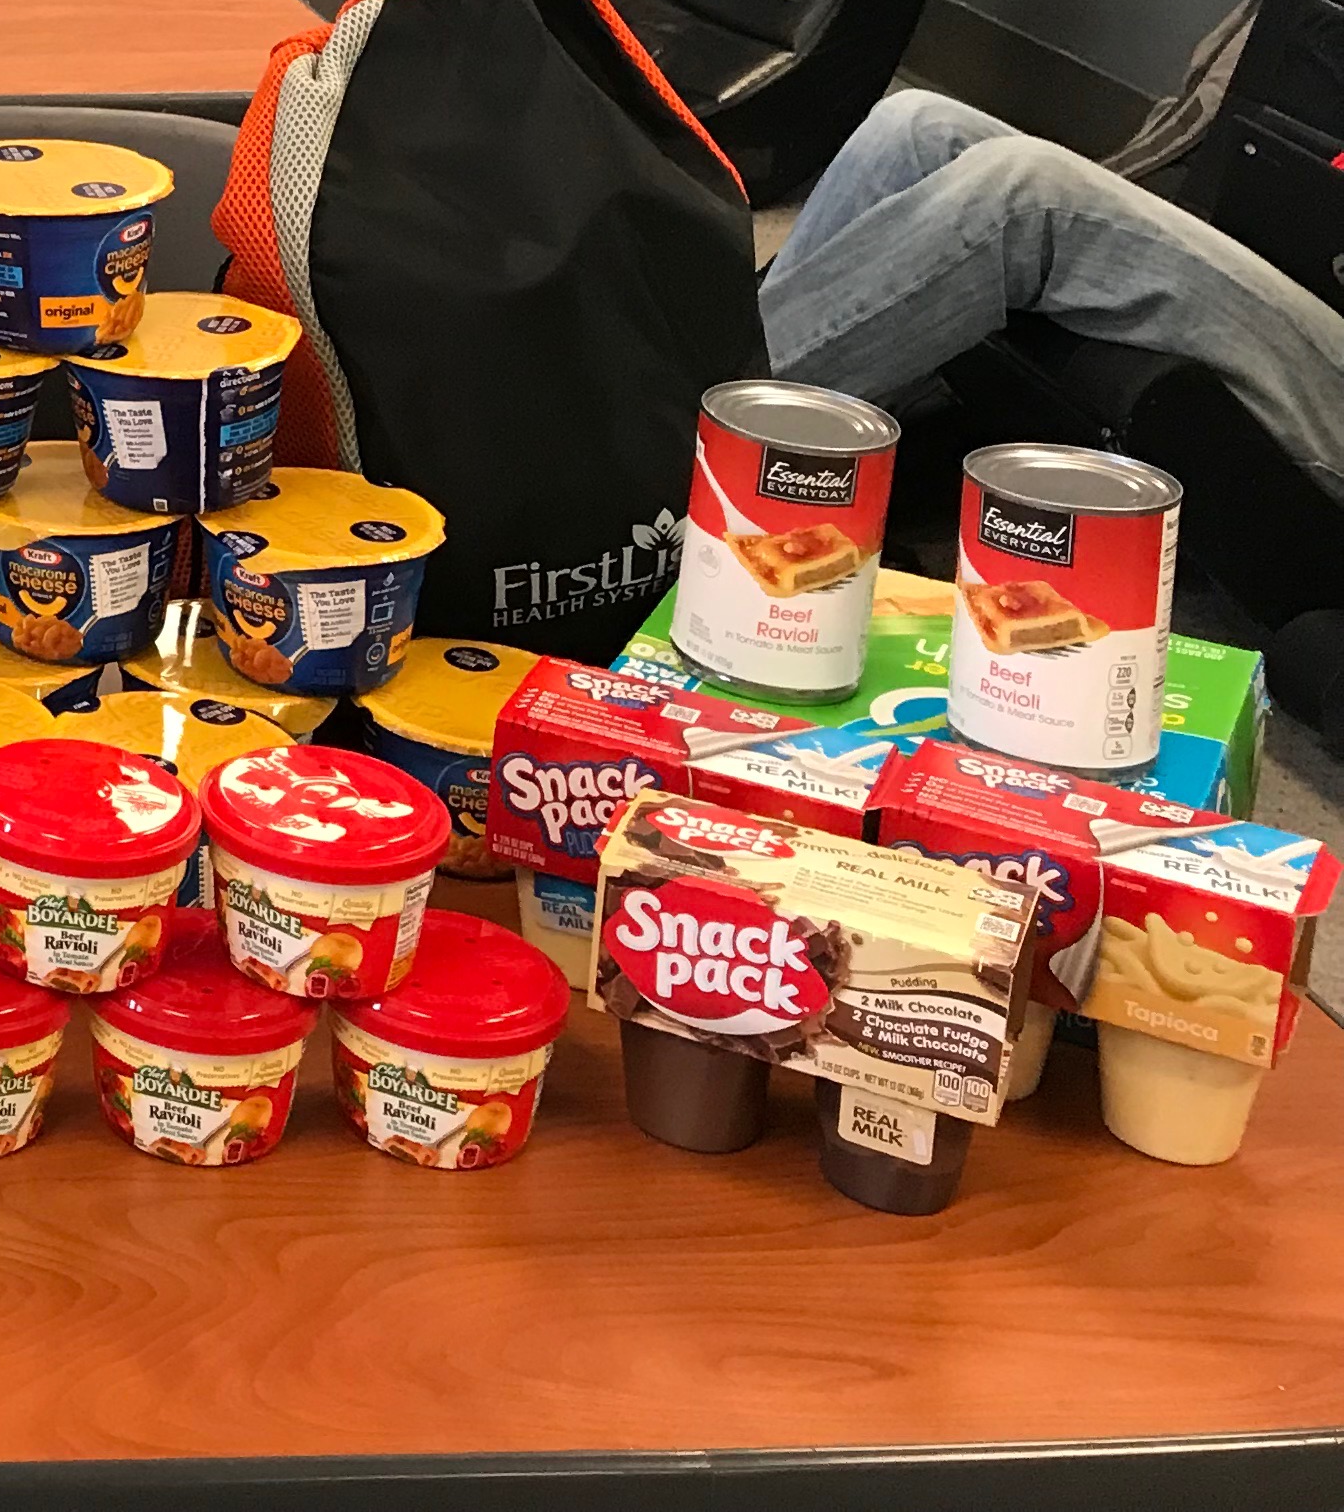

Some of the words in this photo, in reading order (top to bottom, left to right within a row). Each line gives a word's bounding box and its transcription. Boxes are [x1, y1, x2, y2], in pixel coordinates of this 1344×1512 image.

[44, 302, 94, 320] original
[766, 461, 853, 489] Essential
[766, 481, 848, 500] EVERYDAY
[983, 507, 1068, 545] Essential
[983, 528, 1062, 557] EVERYDAY
[27, 550, 52, 563] Kraft
[8, 561, 67, 581] macaroni
[493, 544, 685, 610] FirstLi
[328, 587, 357, 597] Taste
[332, 596, 355, 606] Love
[492, 596, 585, 628] HEALTH
[592, 575, 676, 607] SYSTE
[769, 604, 813, 624] Beef
[734, 631, 774, 651] Tomato
[756, 621, 820, 643] Ravioli
[989, 660, 1033, 687] Beef
[1116, 666, 1131, 679] 220
[570, 672, 671, 701] Snack
[591, 688, 659, 706] pack
[980, 678, 1041, 711] Ravioli
[1038, 714, 1075, 729] Sauce
[745, 760, 815, 782] REAL
[956, 757, 1073, 790] Snack
[502, 757, 655, 811] Snack
[788, 776, 860, 800] MILK!
[983, 775, 1057, 795] pack
[540, 798, 622, 843] pac
[656, 806, 782, 846] Snack
[679, 827, 777, 857] pack
[835, 860, 888, 884] REAL
[894, 875, 952, 897] MILK
[1163, 859, 1243, 883] REAL
[36, 896, 63, 910] Chef
[1209, 878, 1293, 903] MILK!
[27, 904, 118, 933] BOYARDEE
[226, 888, 302, 938] BOYARDEE
[542, 900, 581, 918] REAL
[61, 930, 85, 941] Beef
[558, 915, 593, 931] MIL
[616, 890, 809, 972] Snack
[44, 935, 99, 955] Ravioli
[238, 920, 283, 954] Ravioli
[656, 950, 800, 1014] pack
[890, 977, 938, 989] Pudding
[861, 995, 870, 1006] 2
[874, 997, 905, 1012] Milk
[908, 1001, 983, 1024] Chocolate
[1124, 1000, 1221, 1043] Tapioca
[852, 1009, 862, 1022] 2
[865, 1013, 939, 1037] Chocolate
[943, 1027, 990, 1051] Fudge
[861, 1025, 874, 1038] &
[877, 1029, 910, 1047] Milk
[912, 1034, 988, 1064] Chocolate
[139, 1066, 167, 1080] Chef
[882, 1049, 932, 1067] SMOOTHER
[933, 1058, 967, 1074] RECIPE!
[133, 1072, 222, 1110] BOYARDEE
[368, 1069, 458, 1112] BOYARDEE
[937, 1072, 960, 1091] 100
[965, 1080, 989, 1098] 100
[149, 1104, 202, 1130] Ravioli
[163, 1101, 188, 1115] Beef
[383, 1102, 437, 1131] Ravioli
[398, 1100, 423, 1115] Beef
[853, 1105, 903, 1133] REAL
[851, 1119, 904, 1148] MILK
